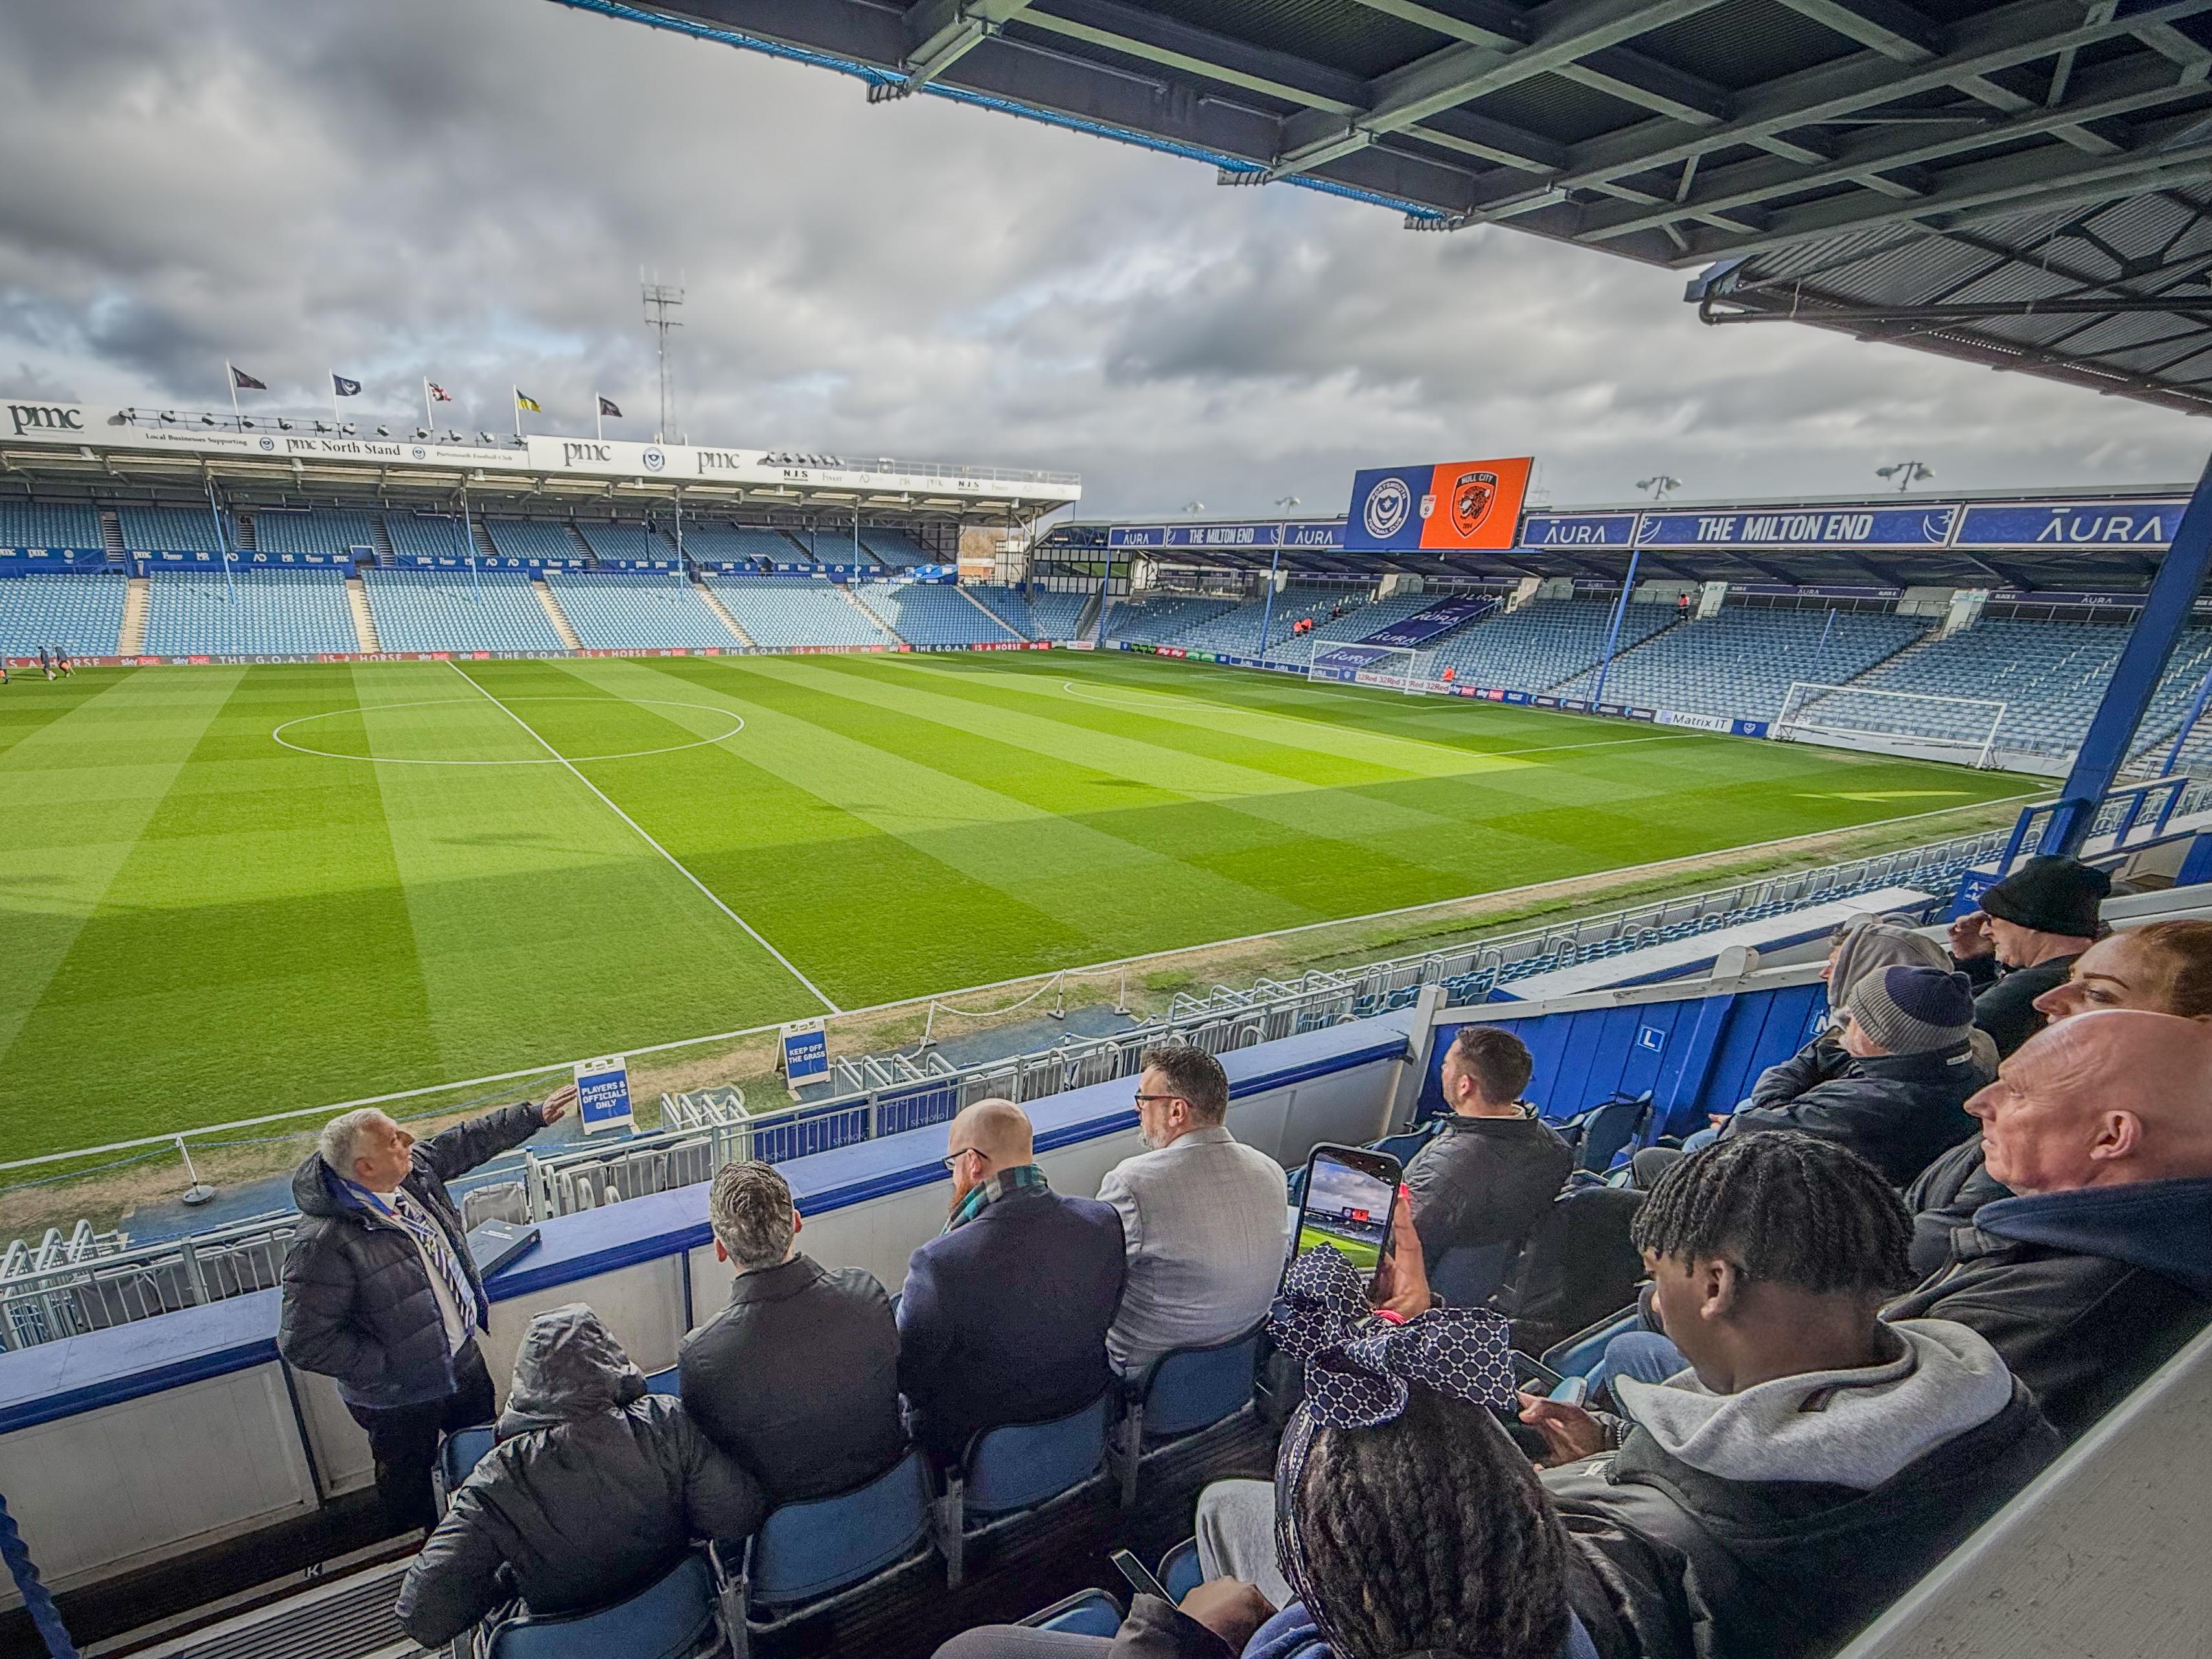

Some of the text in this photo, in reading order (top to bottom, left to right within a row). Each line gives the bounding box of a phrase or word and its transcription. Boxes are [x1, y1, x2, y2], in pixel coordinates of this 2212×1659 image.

[7, 404, 84, 436] pmc
[168, 434, 206, 443] Businesses
[208, 437, 248, 447] Supporting
[286, 438, 401, 456] pmc North Stand
[562, 442, 612, 467] pmc
[697, 451, 740, 474] pmc
[1461, 474, 1493, 484] HULL CITY
[1371, 482, 1407, 500] PORTSMOUTH
[1368, 518, 1389, 535] FOOTBALL
[1389, 517, 1403, 531] CLUB
[1696, 515, 1874, 541] THE MILTON END
[1190, 528, 1254, 544] THE MILTON END
[497, 651, 519, 660] THE
[611, 649, 647, 658] HORSE
[795, 646, 805, 655] IS
[820, 645, 850, 654] HORSE
[915, 644, 932, 653] THE
[995, 642, 1021, 651] HORSE
[121, 658, 138, 667] sky
[190, 656, 209, 665] bet
[219, 656, 246, 664] THE
[324, 655, 336, 663] IS
[360, 653, 402, 662] HORSE
[418, 653, 432, 661] sky
[459, 652, 473, 660] sky
[1401, 679, 1423, 688] 3Red
[1425, 682, 1449, 691] 32Red
[1477, 689, 1489, 699] sky
[1673, 713, 1728, 729] Matrix IT
[1643, 1030, 1655, 1048] L
[789, 1043, 823, 1056] KEEP OFF
[788, 1050, 826, 1064] THE GRASS
[581, 1082, 618, 1096] PLAYERS
[582, 1089, 627, 1104] OFFICIALS
[595, 1098, 617, 1110] ONLY
[306, 1562, 319, 1577] K
